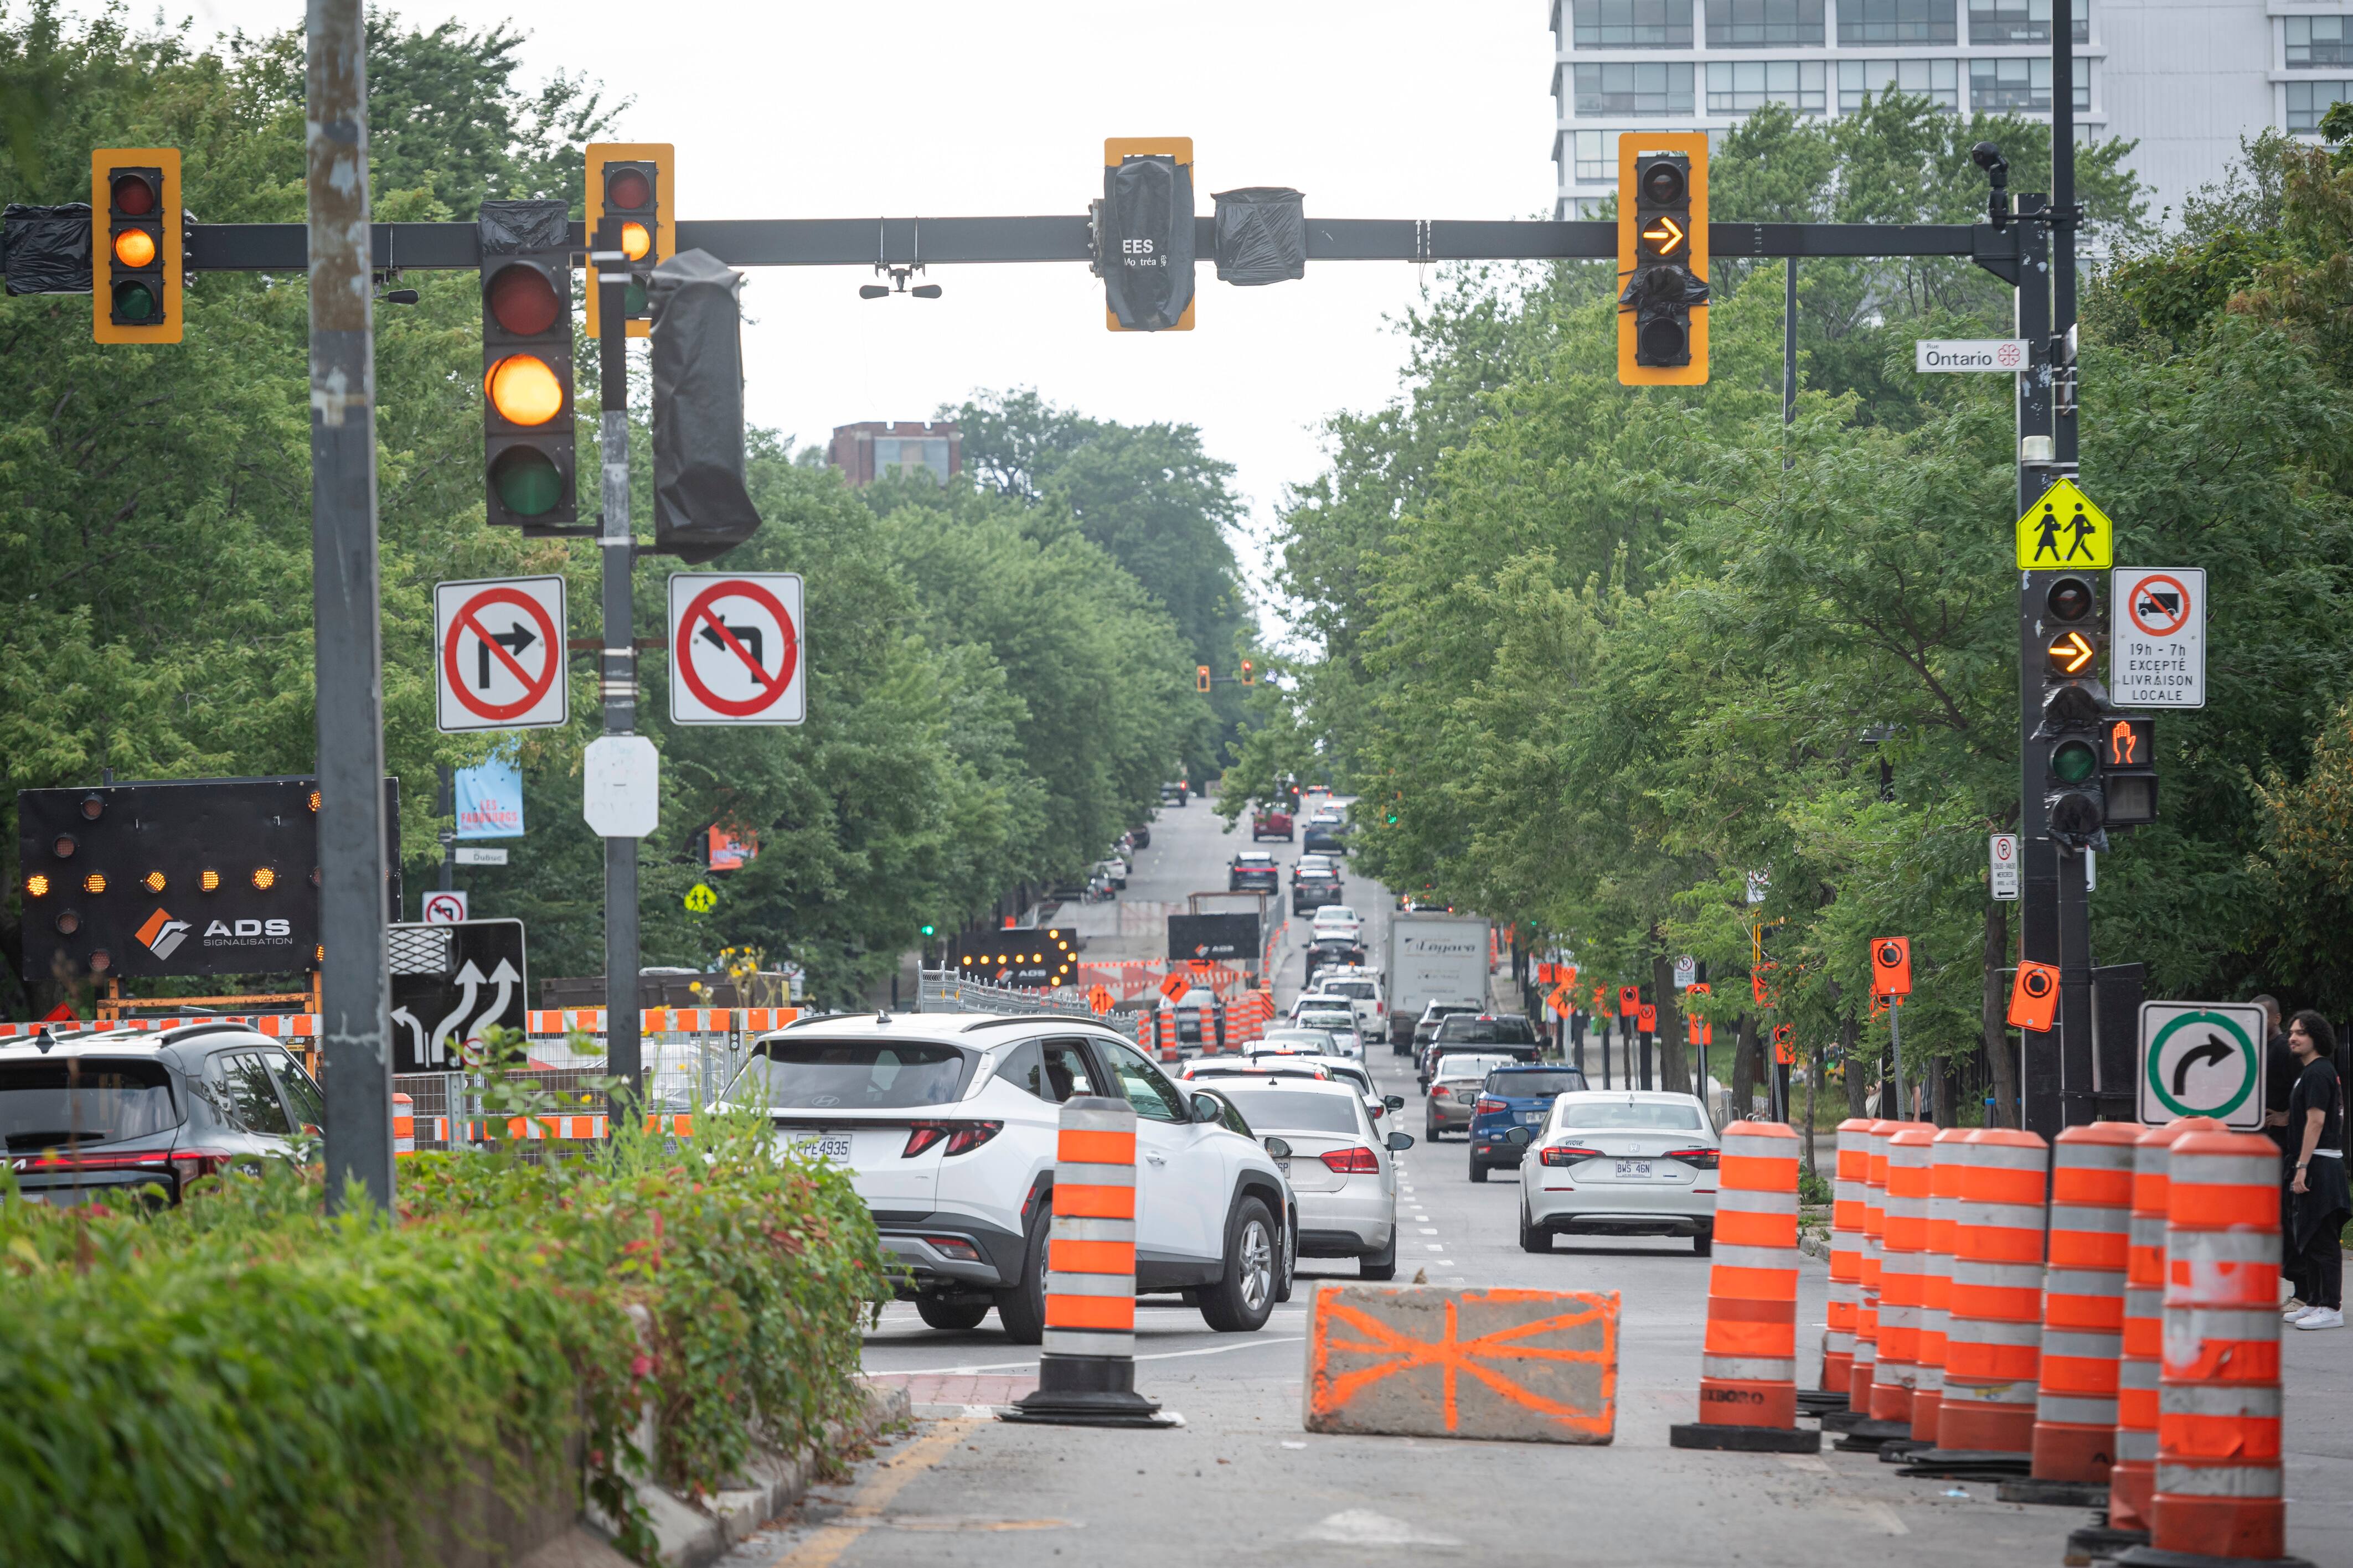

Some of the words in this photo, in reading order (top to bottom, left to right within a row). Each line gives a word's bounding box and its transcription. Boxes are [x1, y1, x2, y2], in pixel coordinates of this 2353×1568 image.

[1927, 351, 1993, 366] Ontario
[2130, 643, 2152, 655] 19h
[2170, 644, 2186, 656] 7h
[2130, 658, 2186, 671] EXCEPTÉ
[2123, 675, 2193, 686] LIVRAISON
[2133, 690, 2183, 701] LOCALE
[479, 800, 497, 811] LES
[203, 919, 291, 936] ADS
[203, 938, 292, 946] SIGNALISATION
[1018, 969, 1046, 977] ADS
[1617, 1165, 1631, 1173] BWS
[1636, 1165, 1650, 1173] 46N
